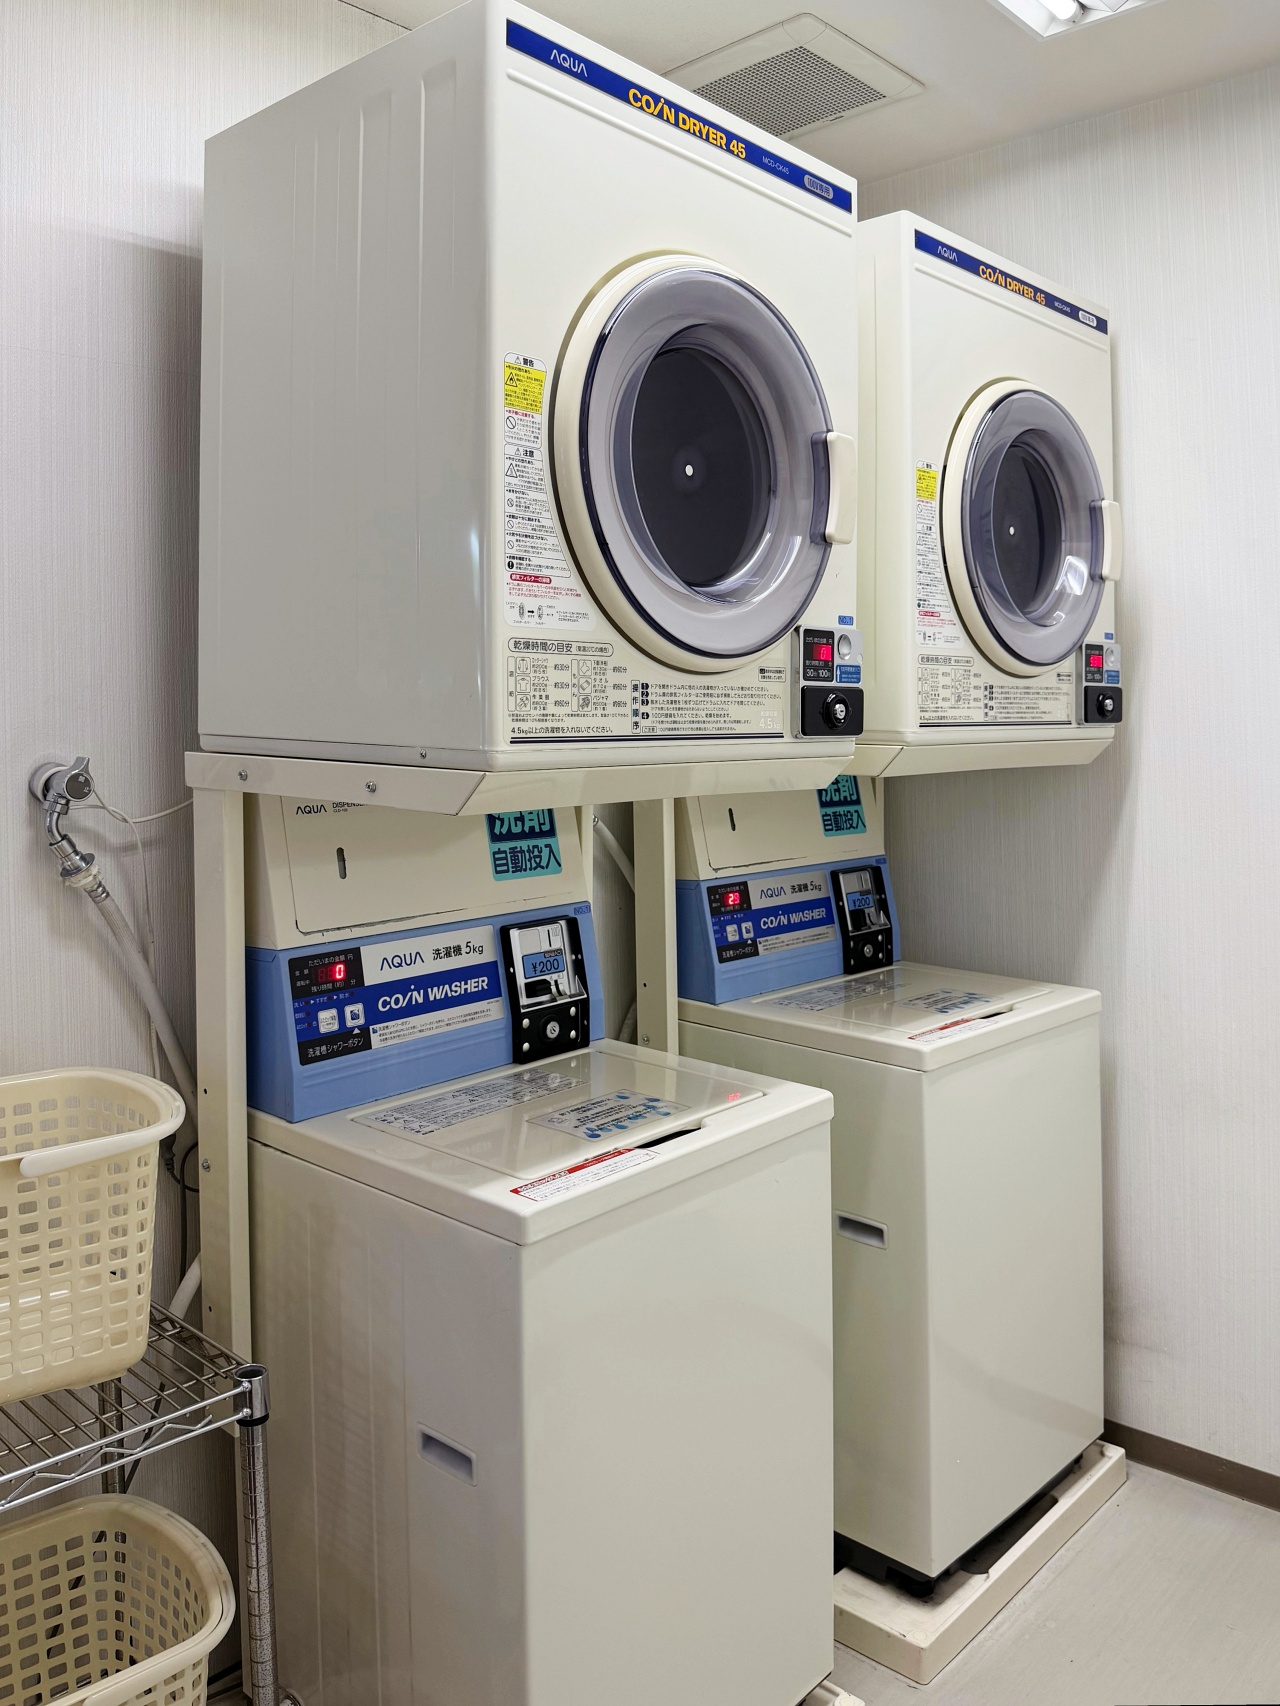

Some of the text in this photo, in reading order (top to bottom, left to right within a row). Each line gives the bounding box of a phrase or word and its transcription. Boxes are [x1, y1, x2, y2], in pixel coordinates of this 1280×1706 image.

[679, 110, 727, 150] DRYER
[729, 139, 746, 159] 45
[1006, 277, 1034, 300] DRYER
[1036, 291, 1046, 305] 45
[522, 449, 534, 458] 注意
[513, 640, 573, 653] 乾燥時間の目安
[822, 809, 866, 832] 自動投入
[493, 844, 562, 875] 自動投入
[790, 883, 809, 894] 洗濯機
[810, 881, 822, 891] 5kg
[574, 905, 590, 915] NO.1
[851, 897, 871, 908] ¥200
[789, 908, 826, 923] WASHER
[432, 945, 463, 961] 洗濯機
[465, 941, 484, 956] 5kg
[308, 953, 354, 967] ただいまの金額 円
[532, 958, 560, 975] ¥200
[335, 964, 344, 979] 0
[427, 976, 488, 1001] WASHER
